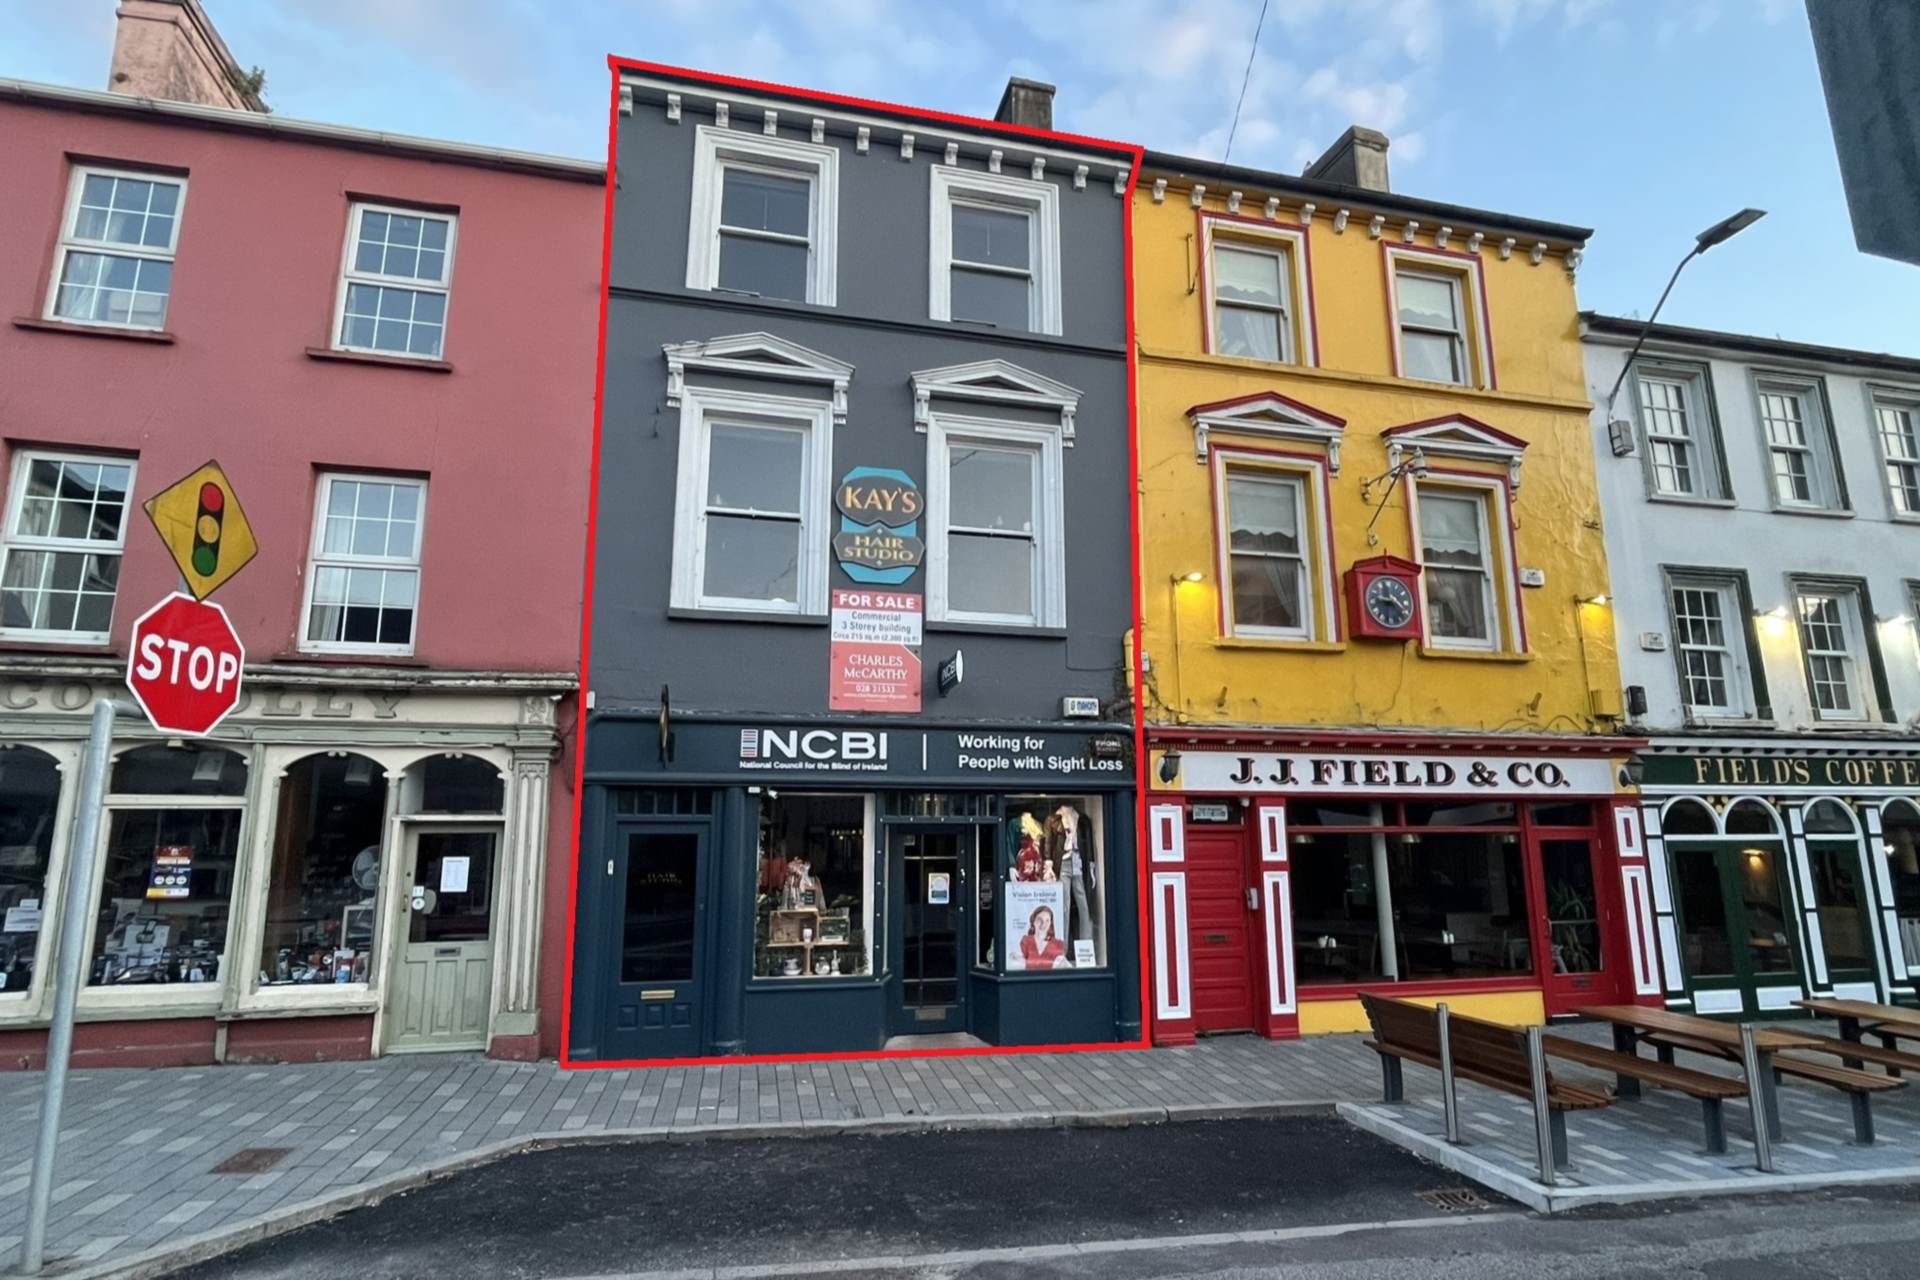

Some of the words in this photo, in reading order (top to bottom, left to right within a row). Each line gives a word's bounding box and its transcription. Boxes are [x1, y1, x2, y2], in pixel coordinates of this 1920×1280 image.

[844, 486, 917, 513] KAY'S
[854, 535, 904, 549] HAIR
[844, 546, 914, 560] STUDIO
[839, 593, 873, 606] FOR
[876, 597, 915, 609] SALE
[851, 610, 902, 621] Commercial
[841, 621, 848, 630] 3
[849, 621, 876, 632] Storey
[878, 624, 912, 634] building
[136, 633, 238, 694] STOP
[848, 654, 904, 667] CHARLES
[843, 667, 908, 680] McCARTHY
[762, 730, 888, 760] NCBI
[958, 735, 1020, 752] Working
[1024, 736, 1045, 750] for
[740, 761, 772, 769] National
[773, 761, 803, 769] Council
[804, 761, 816, 769] for
[817, 762, 830, 770] the
[831, 762, 852, 770] Blind
[861, 763, 888, 771] Ireland
[958, 755, 1010, 772] People
[1013, 756, 1044, 770] with
[1047, 756, 1086, 773] Sight
[1089, 757, 1123, 771] Loss
[1694, 758, 1811, 785] FIELD'S
[1825, 760, 1919, 785] COFFE
[1310, 759, 1456, 787] FIELD
[1466, 761, 1498, 787] &
[1507, 761, 1571, 788] CO.
